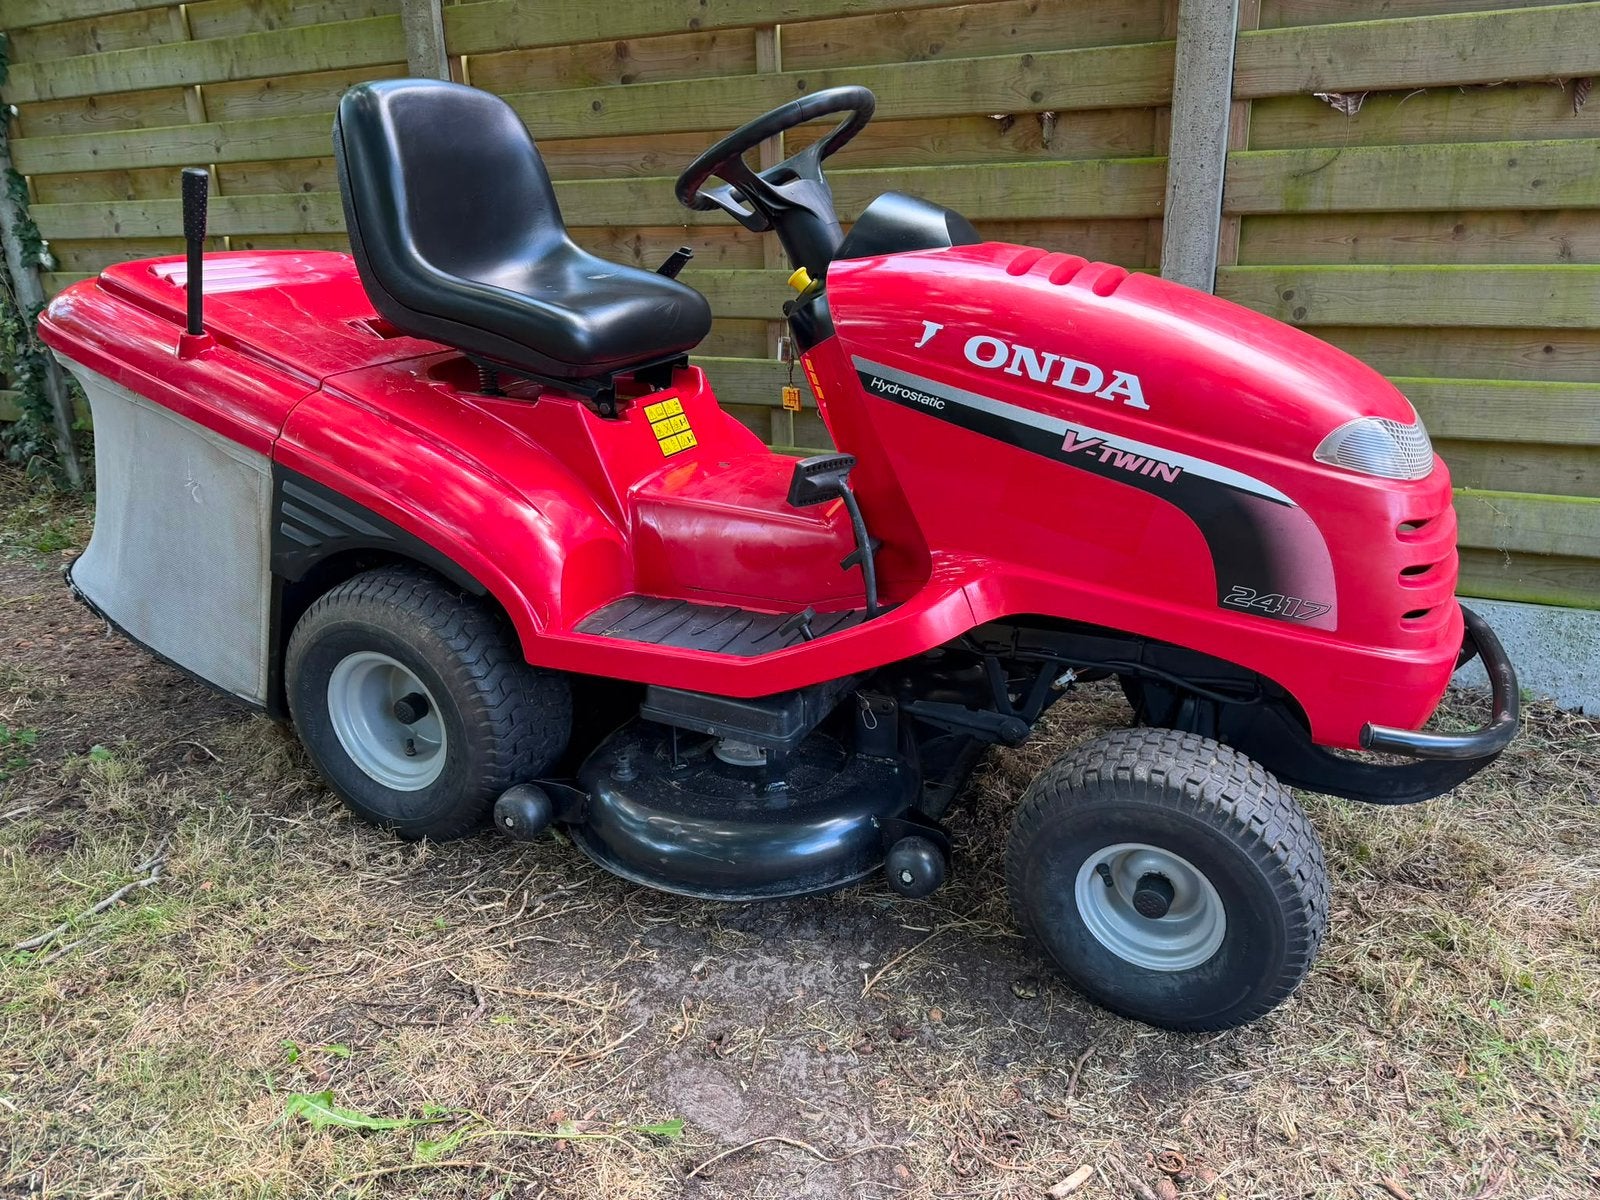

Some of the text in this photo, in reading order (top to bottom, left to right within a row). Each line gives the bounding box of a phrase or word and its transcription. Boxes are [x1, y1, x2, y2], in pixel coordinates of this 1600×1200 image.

[870, 377, 945, 410] Hydrostatic
[1061, 429, 1183, 483] V-TWIN
[1223, 585, 1332, 620] 2417
